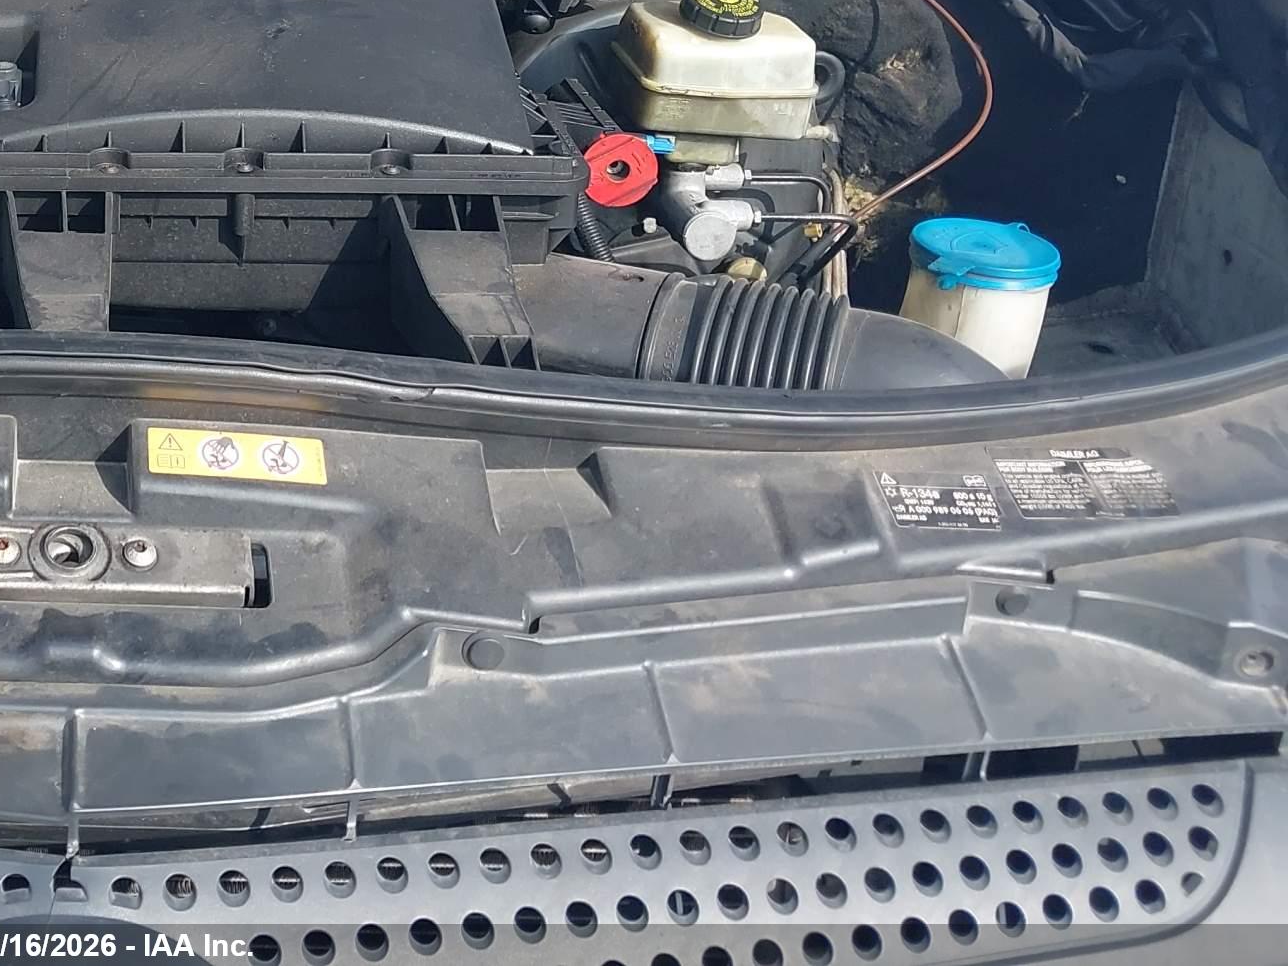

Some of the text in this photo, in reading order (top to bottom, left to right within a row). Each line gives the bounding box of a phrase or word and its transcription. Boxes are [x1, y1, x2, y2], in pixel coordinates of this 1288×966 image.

[1049, 450, 1100, 459] DAIMLER AG
[899, 488, 941, 500] R-134a
[915, 506, 932, 514] 000
